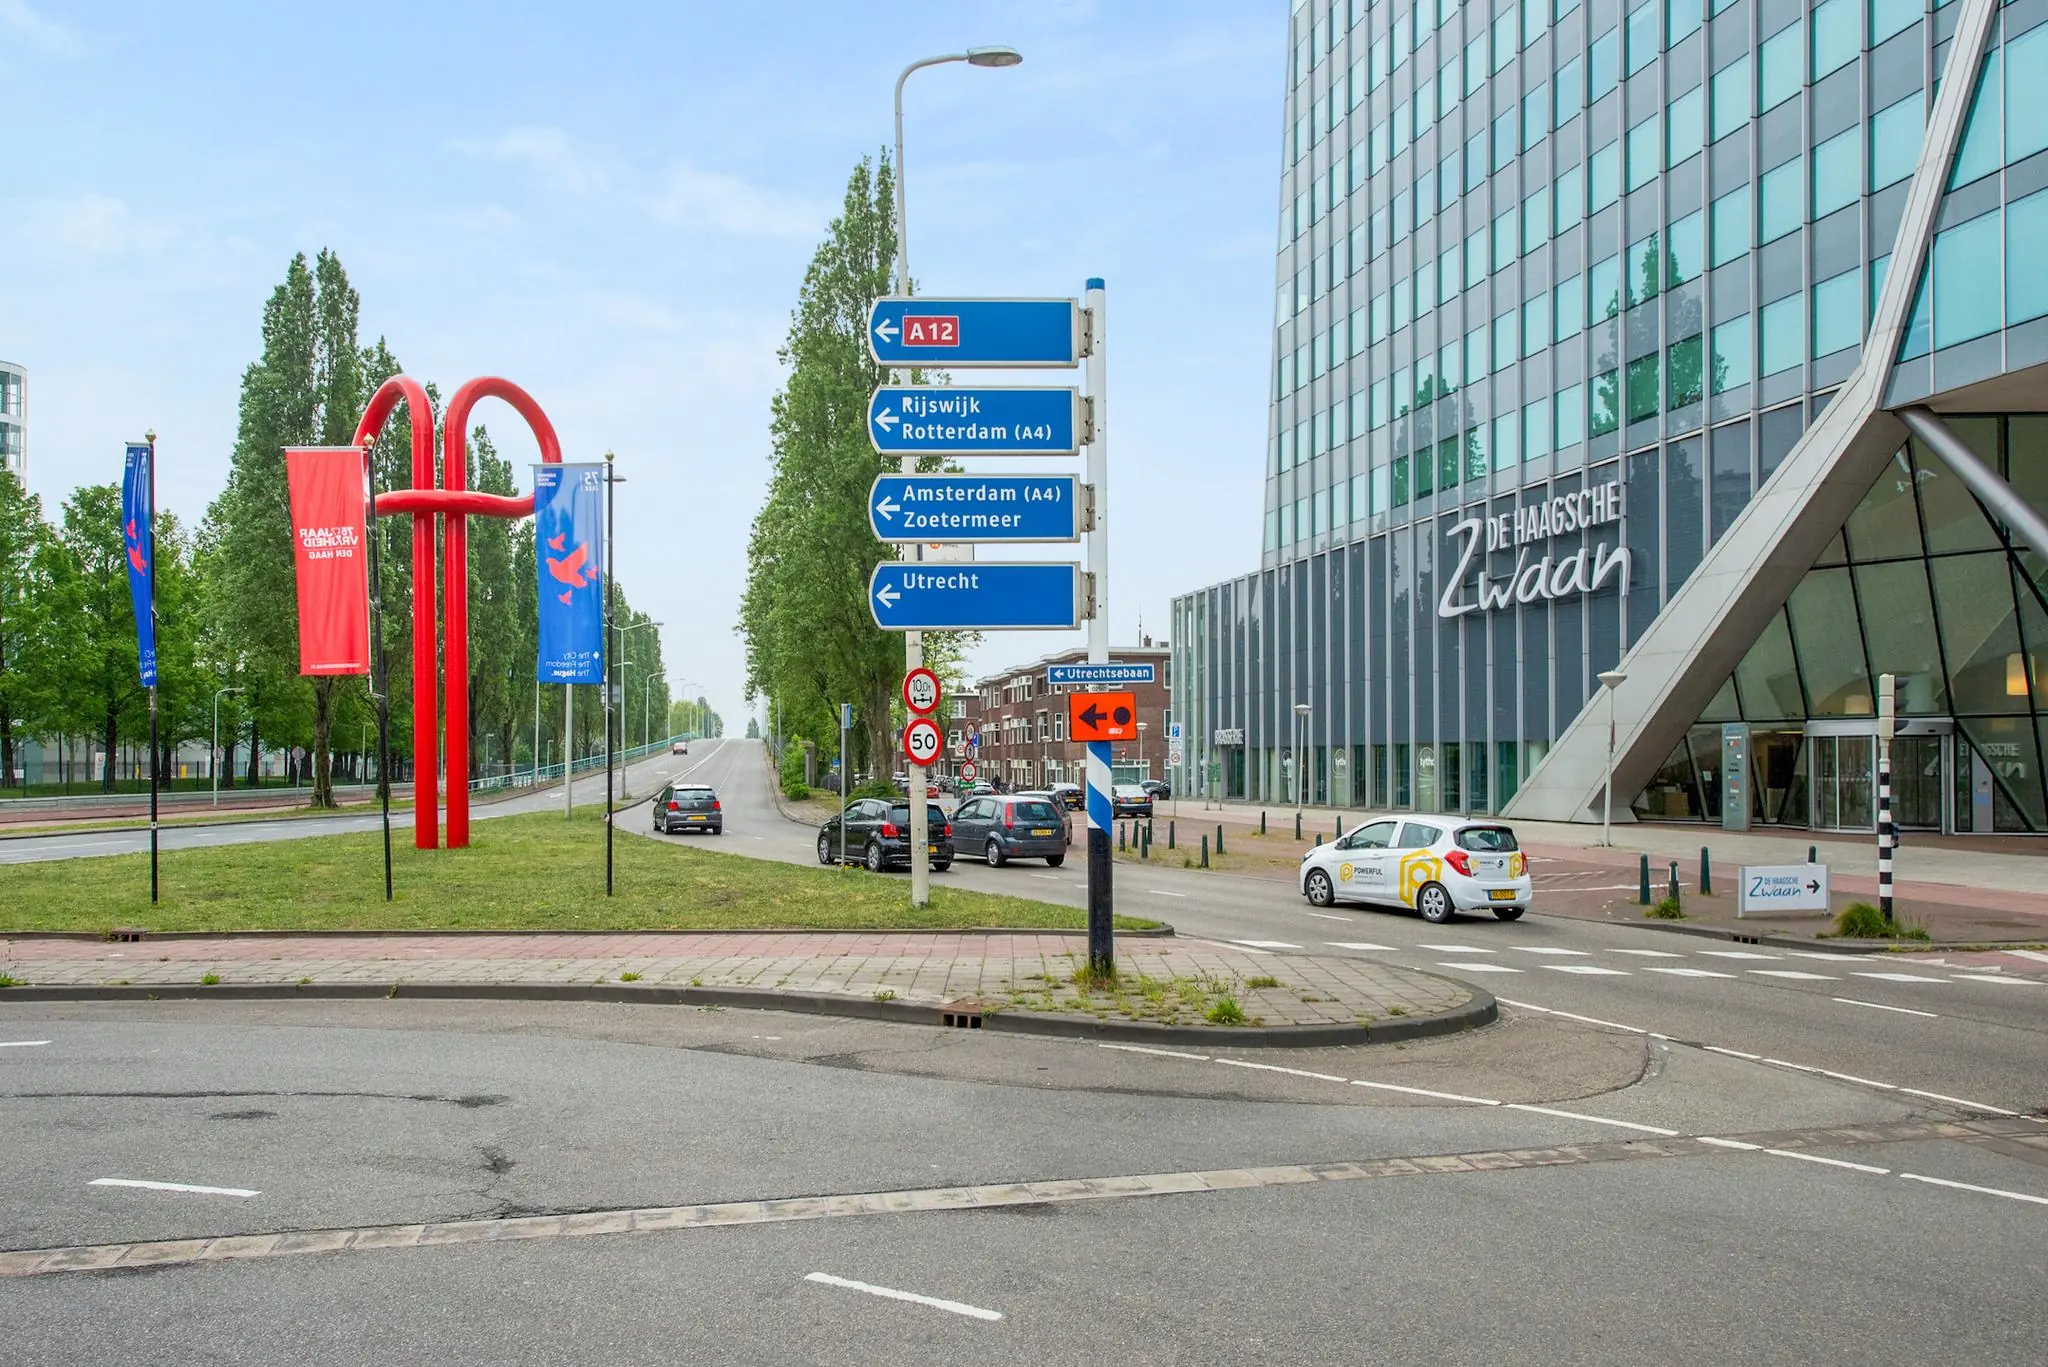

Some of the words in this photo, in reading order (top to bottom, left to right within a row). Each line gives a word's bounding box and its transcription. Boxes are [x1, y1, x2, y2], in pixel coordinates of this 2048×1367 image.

[909, 322, 953, 341] A12
[902, 396, 980, 417] Rijswijk
[902, 423, 1007, 440] Rotterdam
[1014, 424, 1052, 441] (A4)
[902, 485, 1016, 501] Amsterdam
[1024, 486, 1061, 502] (A4)
[904, 511, 1022, 528] Zoetermeer
[1487, 513, 1512, 552] DE
[1514, 480, 1621, 545] HAAGSCHE
[1438, 518, 1632, 618] Zwaan
[903, 573, 979, 590] Utrecht
[1067, 667, 1150, 679] Utrechtsebaan
[912, 733, 936, 750] 50
[1353, 866, 1383, 876] POWERFUL
[1749, 876, 1802, 898] Zwaan
